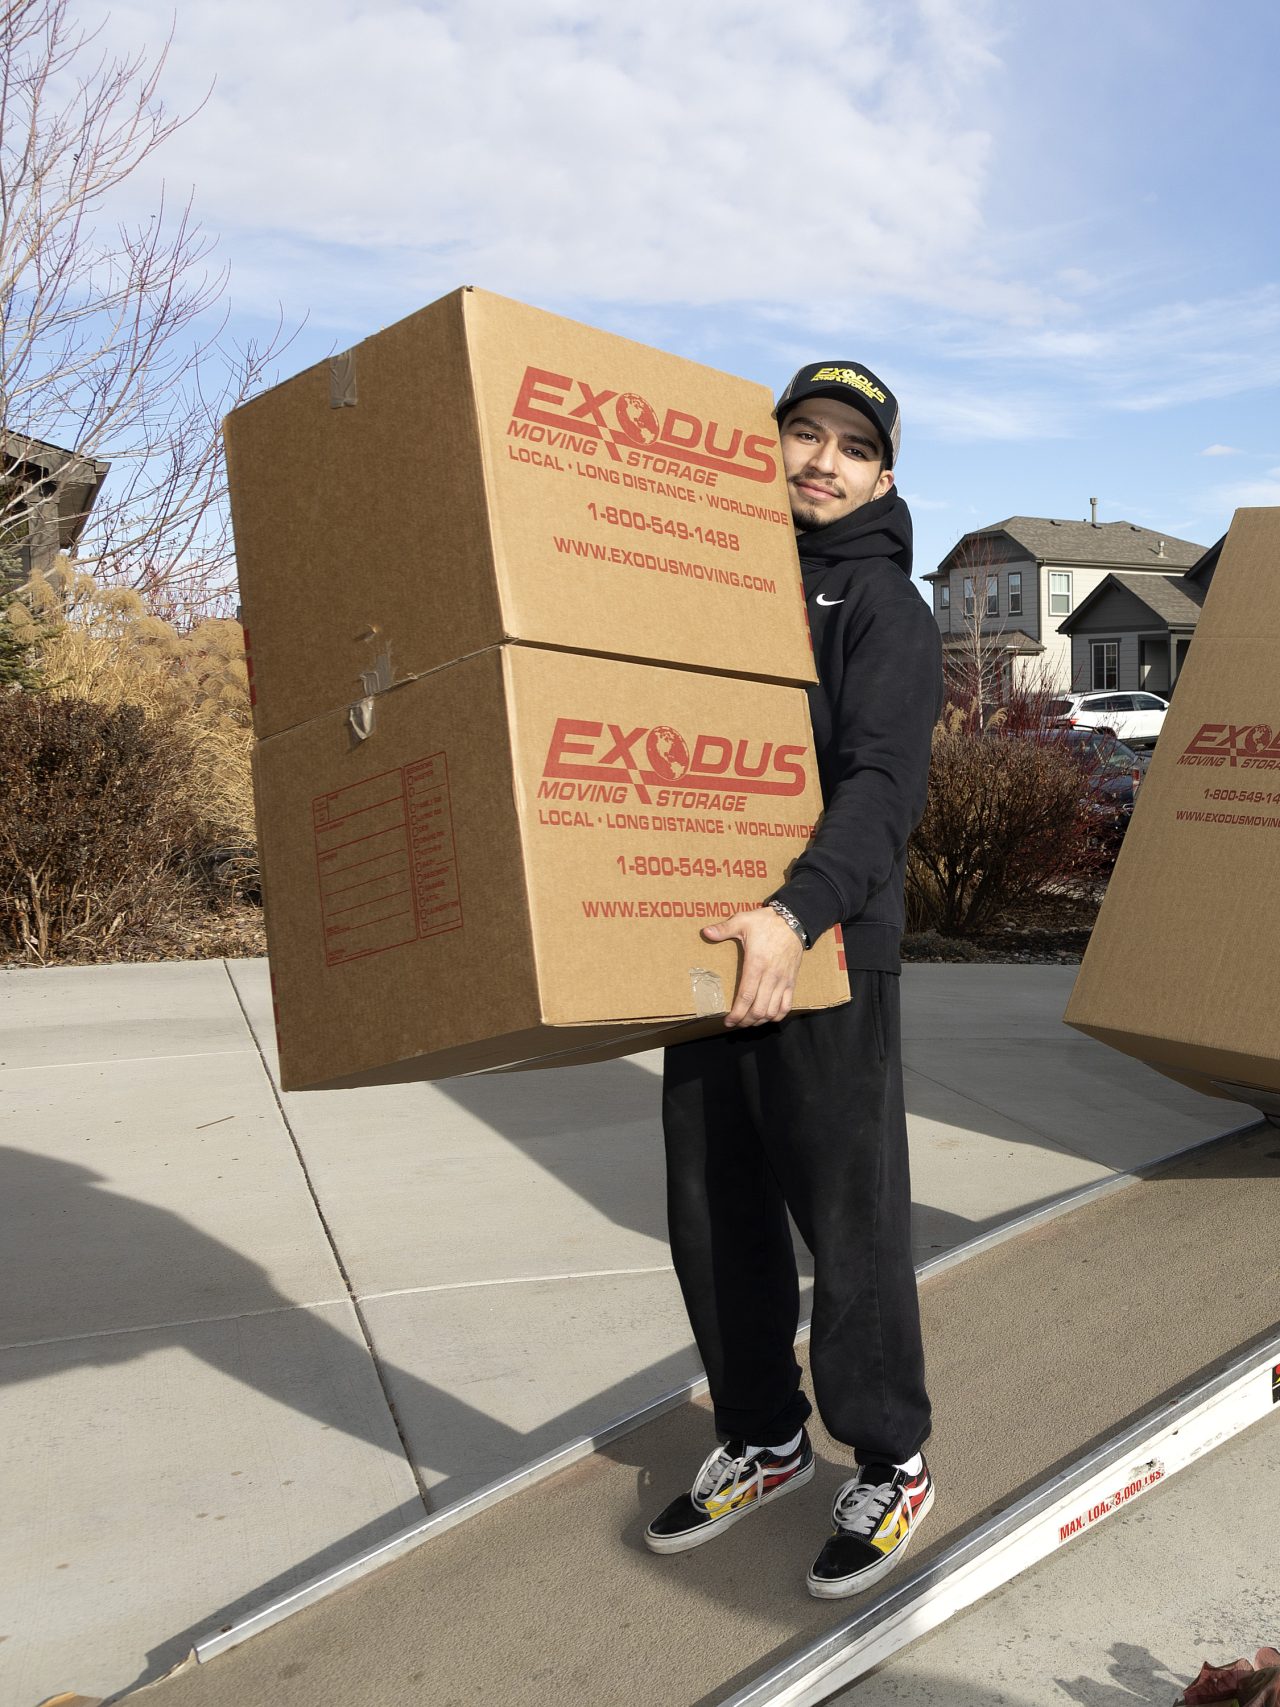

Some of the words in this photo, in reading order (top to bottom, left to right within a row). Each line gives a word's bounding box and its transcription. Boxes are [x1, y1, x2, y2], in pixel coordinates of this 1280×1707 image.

[814, 367, 887, 404] EXODUS
[512, 366, 777, 484] EXODUS
[506, 420, 598, 456] MOVING
[626, 451, 719, 488] STORAGE
[508, 445, 564, 471] LOCAL
[577, 463, 620, 485] LONG
[623, 474, 696, 503] DISTANCE
[706, 494, 789, 526] WORLDWIDE
[587, 502, 740, 551] 1-800-549-1488
[553, 536, 777, 594] WWW.EXODUSMOVING.COM
[542, 718, 808, 804] EXODUS
[1176, 755, 1226, 768] MOVING
[537, 781, 628, 804] MOVING
[656, 790, 748, 812] STORAGE
[538, 809, 594, 827] LOCAL
[607, 814, 649, 829] LONG
[652, 816, 724, 834] DISTANCE
[735, 821, 816, 839] WORLDWIDE
[617, 856, 767, 879] 1-800-549-1488
[1059, 1515, 1086, 1541] MAX.
[1114, 1479, 1142, 1507] 3,000
